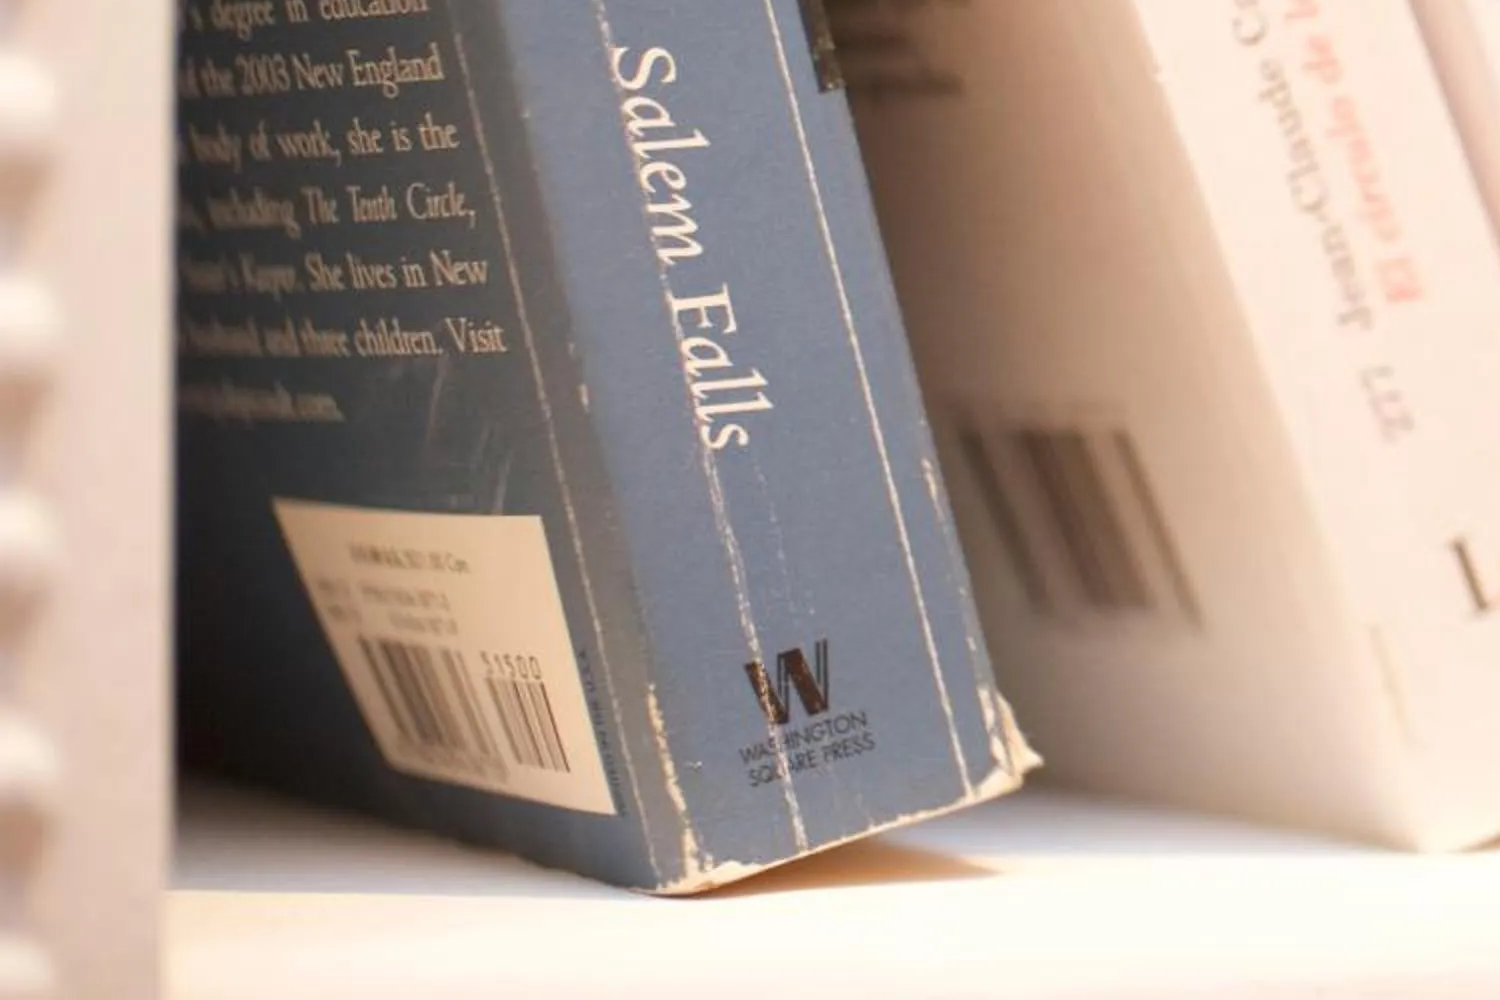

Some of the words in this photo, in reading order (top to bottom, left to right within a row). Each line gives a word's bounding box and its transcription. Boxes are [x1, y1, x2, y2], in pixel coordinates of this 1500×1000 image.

[236, 52, 292, 96] 2003
[292, 51, 345, 90] New
[347, 42, 445, 98] England
[276, 119, 342, 167] work,
[346, 116, 385, 155] she
[390, 120, 413, 152] is
[417, 111, 461, 151] the
[302, 185, 341, 225] The
[346, 184, 398, 223] Tenth
[406, 181, 477, 229] Circle,
[304, 251, 346, 292] She
[346, 250, 398, 290] lives
[401, 254, 428, 289] in
[428, 248, 490, 287] New
[606, 45, 712, 267] Salem
[666, 282, 775, 452] Falls
[353, 316, 444, 357] children.
[443, 316, 509, 354] Visit
[822, 732, 876, 763] PRESS
